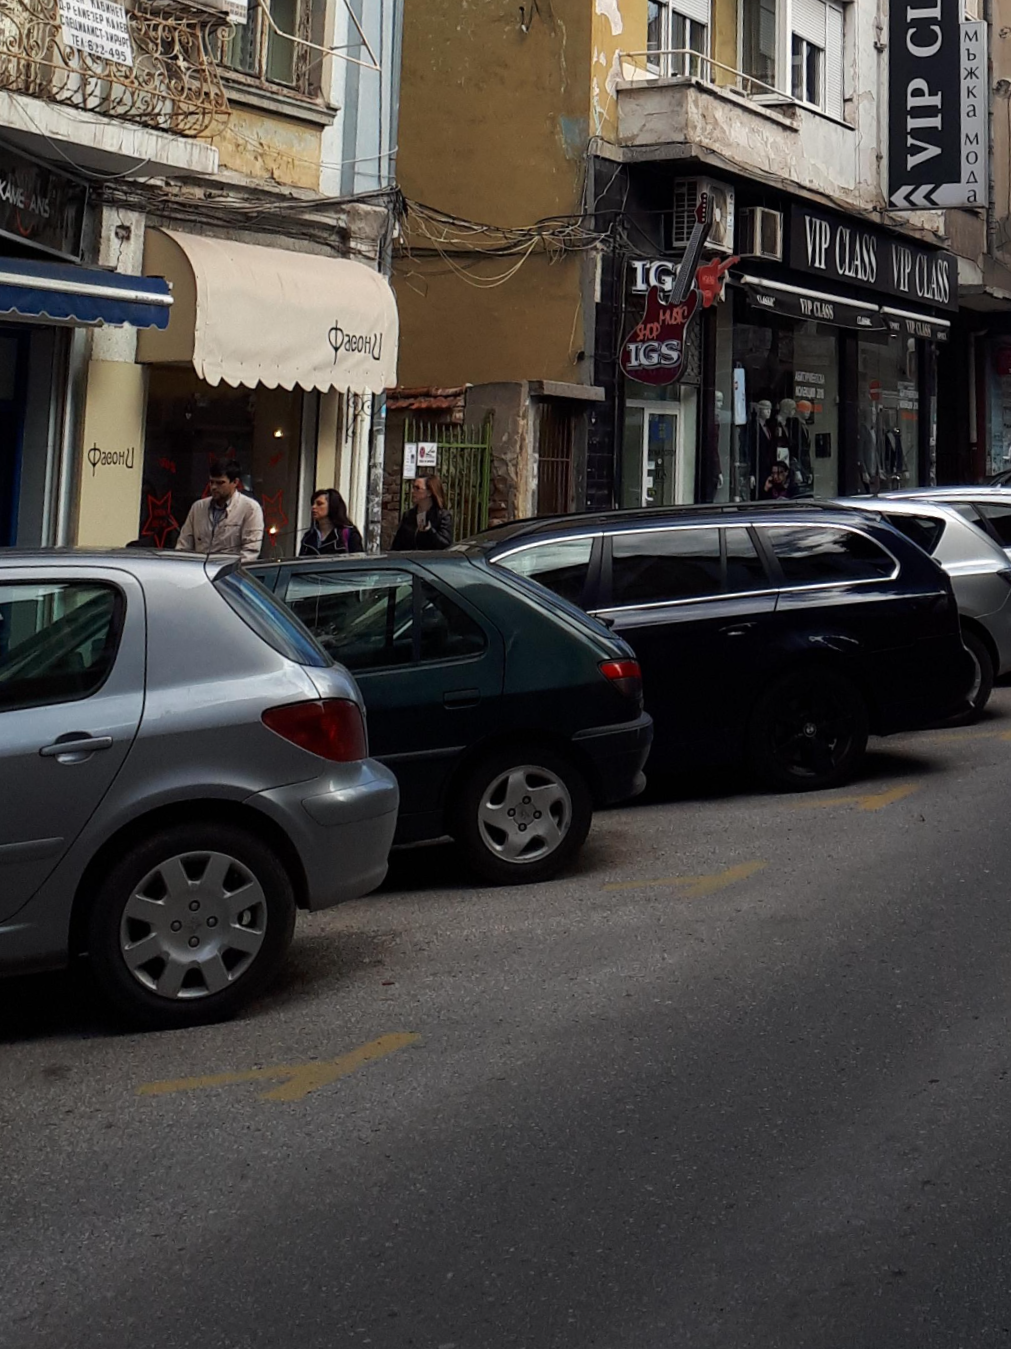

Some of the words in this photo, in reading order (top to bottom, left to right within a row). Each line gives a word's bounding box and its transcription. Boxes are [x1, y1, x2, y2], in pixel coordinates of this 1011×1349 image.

[906, 77, 942, 171] VIP
[804, 214, 831, 270] VIP
[835, 225, 878, 284] CLASS
[891, 243, 912, 293] VIP
[915, 253, 949, 304] CLASS
[659, 305, 688, 325] MUSIC
[800, 297, 812, 316] VIP
[813, 301, 834, 320] CLASS
[636, 322, 660, 341] SHOP
[905, 319, 916, 334] VIP
[916, 321, 932, 338] CLASS
[626, 339, 682, 370] IGS
